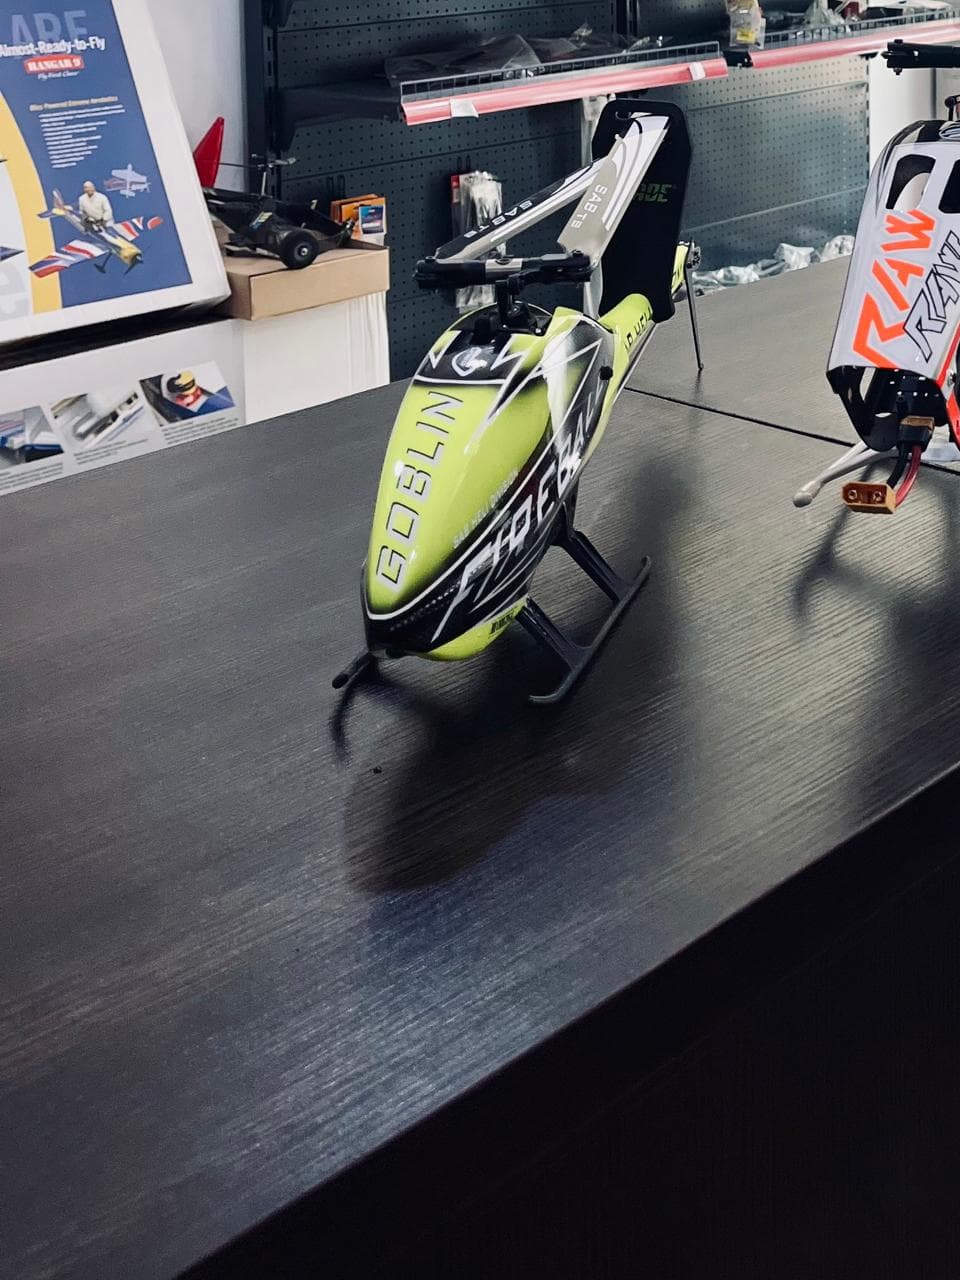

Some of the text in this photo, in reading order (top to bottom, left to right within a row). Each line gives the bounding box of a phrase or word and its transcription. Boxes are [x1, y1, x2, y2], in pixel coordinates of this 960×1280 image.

[584, 184, 608, 214] SAB
[852, 209, 937, 369] RAW
[375, 390, 464, 594] GOBLIN
